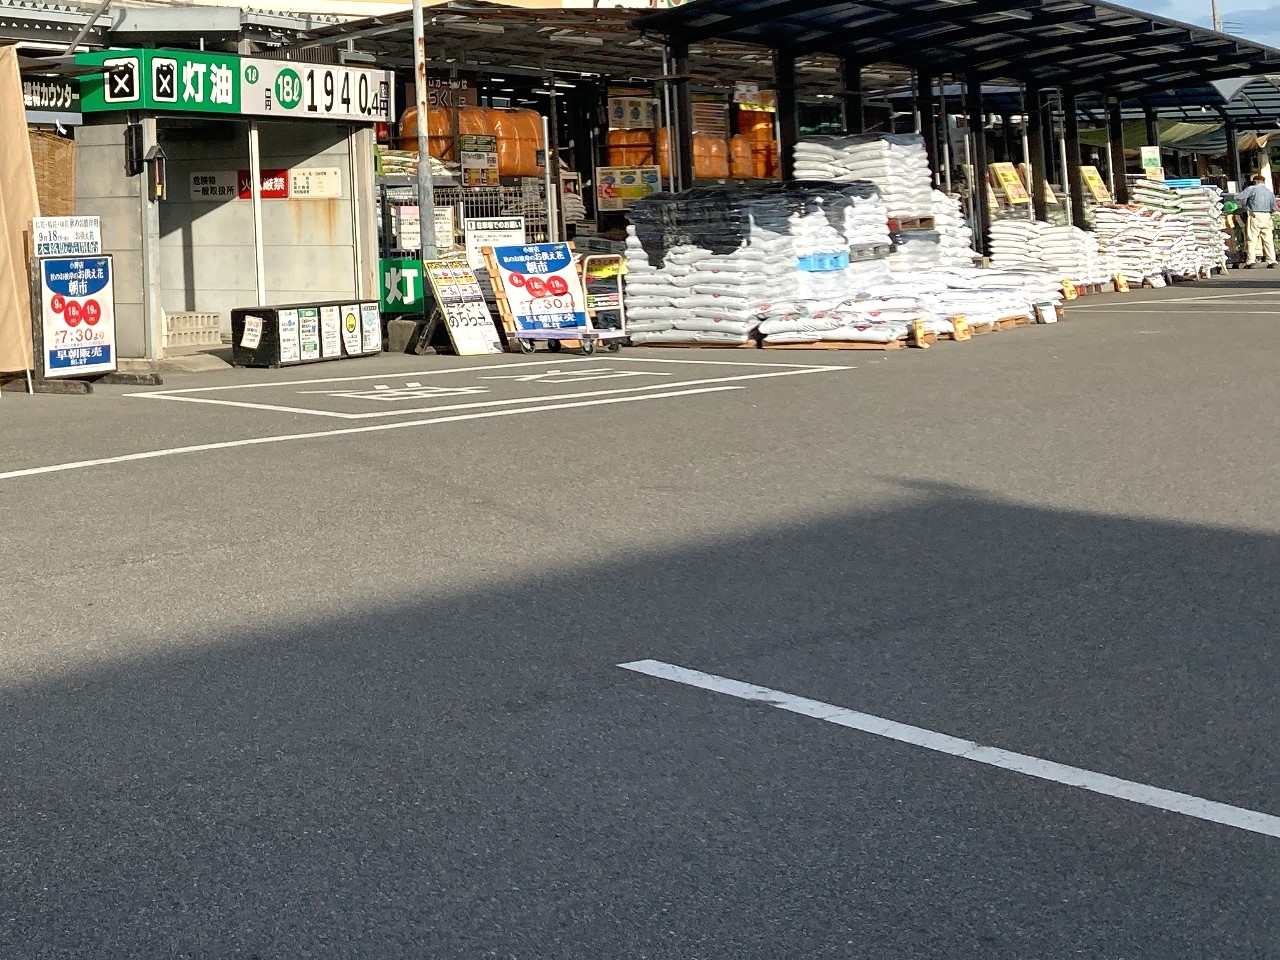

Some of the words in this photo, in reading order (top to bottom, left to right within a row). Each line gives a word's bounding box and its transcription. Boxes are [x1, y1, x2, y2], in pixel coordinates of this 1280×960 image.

[182, 60, 234, 105] 灯油
[192, 176, 216, 186] 危険物
[241, 177, 285, 191] 火厳禁
[68, 280, 88, 296] 朝市
[384, 268, 419, 305] 灯
[55, 346, 103, 361] 早朝販売
